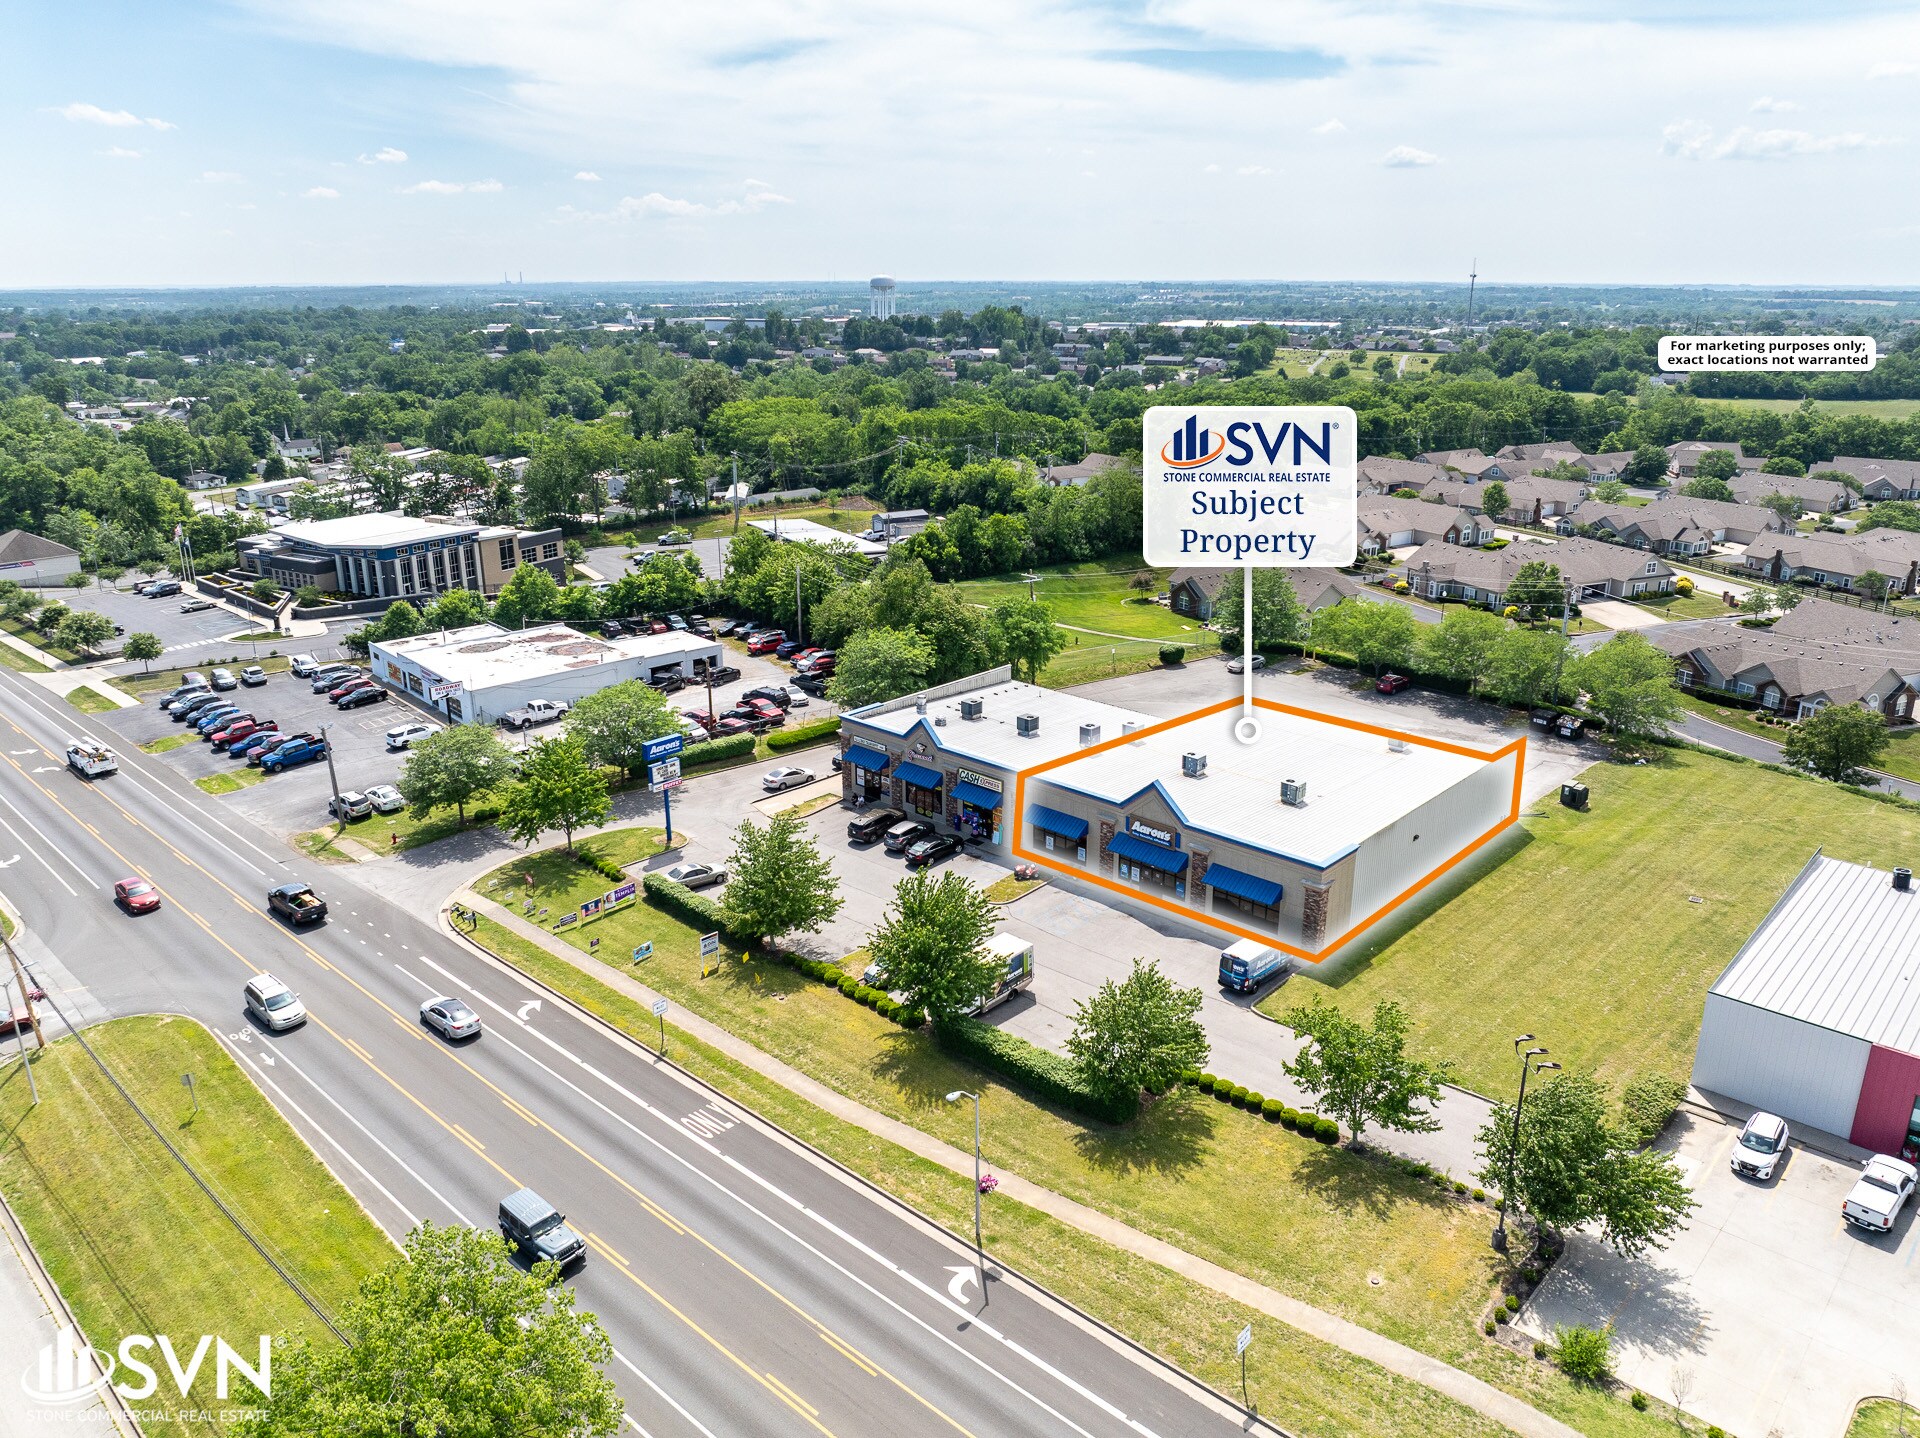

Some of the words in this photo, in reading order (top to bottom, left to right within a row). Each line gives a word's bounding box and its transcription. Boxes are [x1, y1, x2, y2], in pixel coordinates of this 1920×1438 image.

[650, 740, 680, 754] Aaron's
[960, 770, 980, 785] CASH
[1131, 821, 1171, 841] Aaron's
[680, 1101, 740, 1139] ONLY
